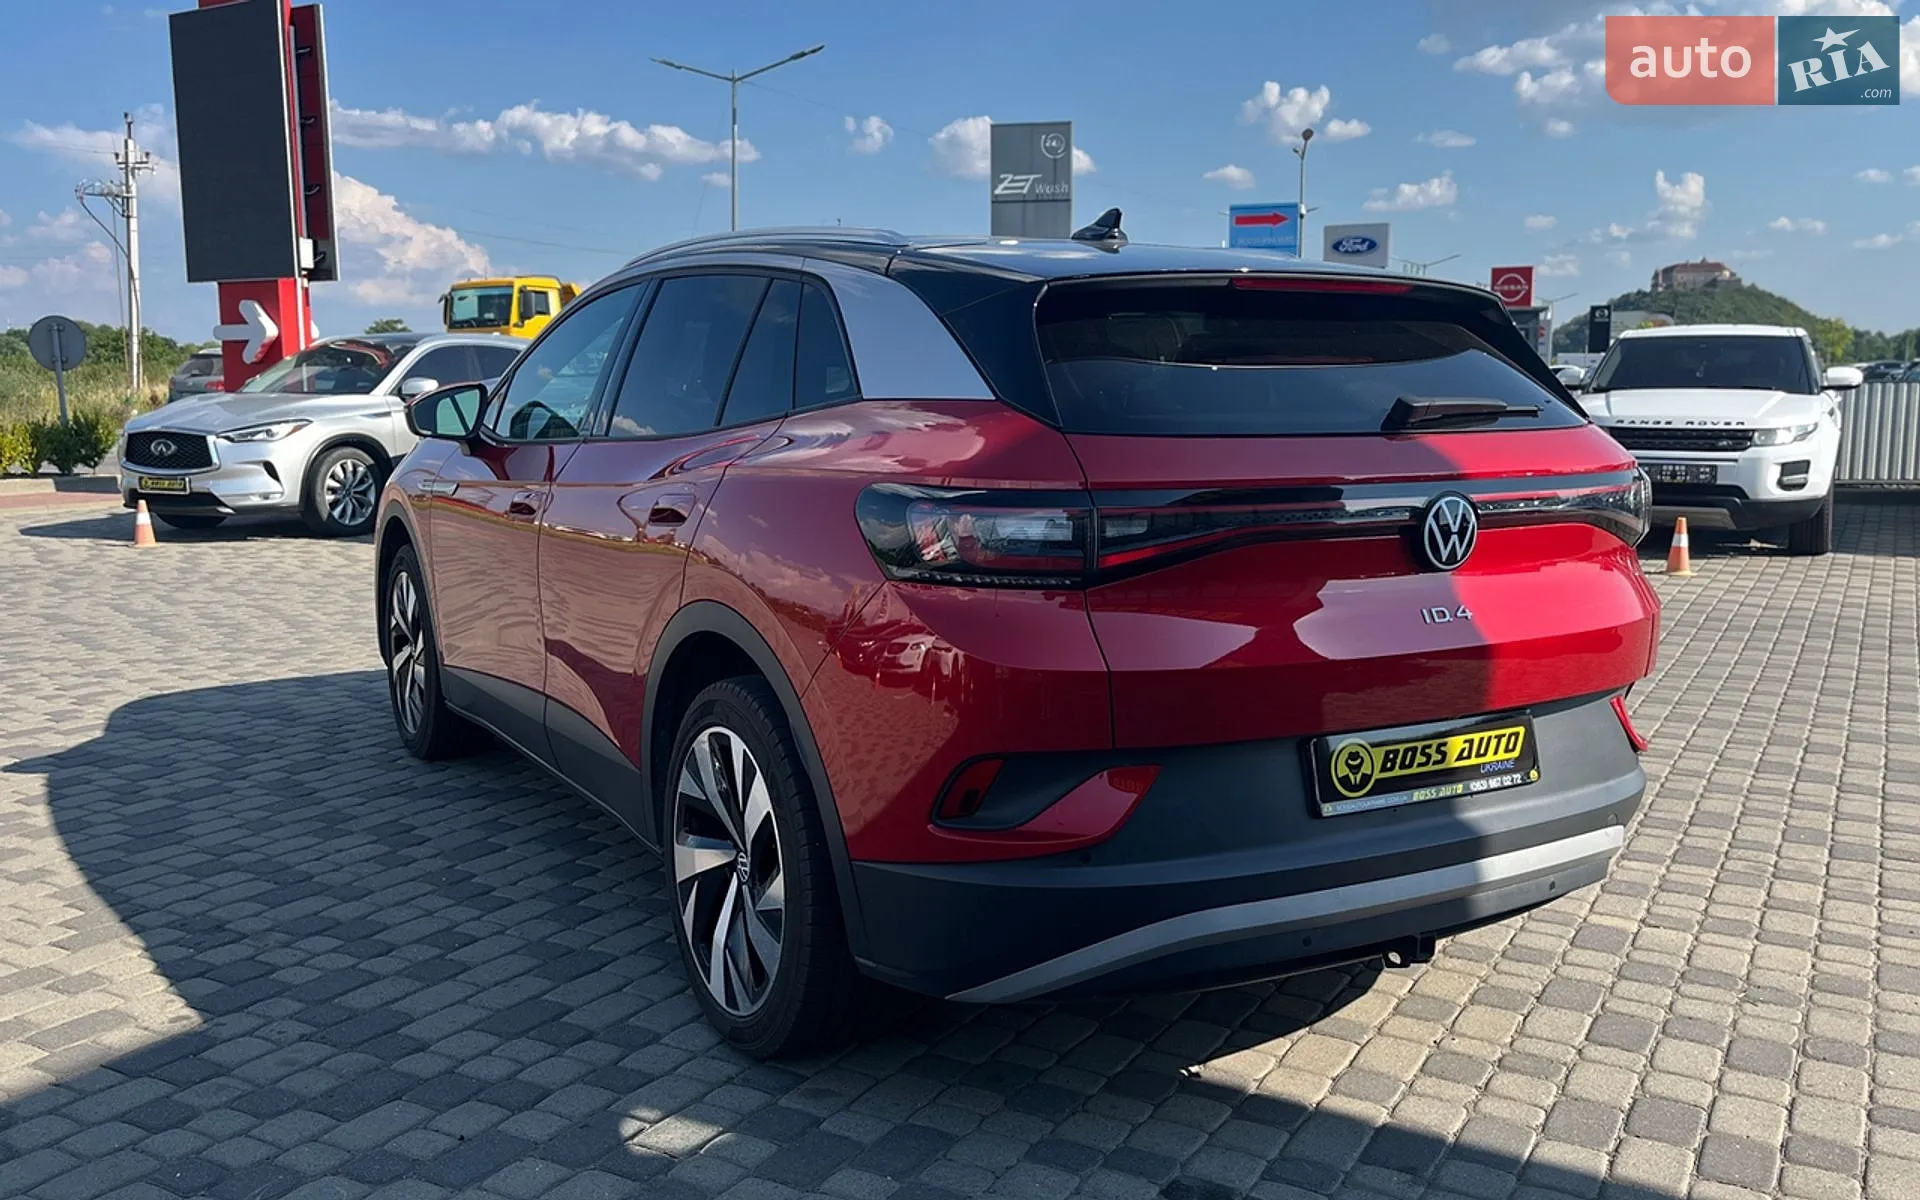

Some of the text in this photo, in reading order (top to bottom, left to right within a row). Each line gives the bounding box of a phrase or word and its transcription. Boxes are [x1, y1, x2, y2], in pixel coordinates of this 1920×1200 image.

[994, 173, 1069, 195] ZET Wash
[1338, 237, 1371, 253] Ford
[1493, 283, 1529, 291] NISSAN
[1421, 604, 1473, 624] ID.4
[1379, 731, 1521, 773] BOSS AUTO
[1480, 760, 1515, 774] UKRAINE
[1412, 788, 1437, 801] BOSS
[1438, 784, 1463, 797] AUTO
